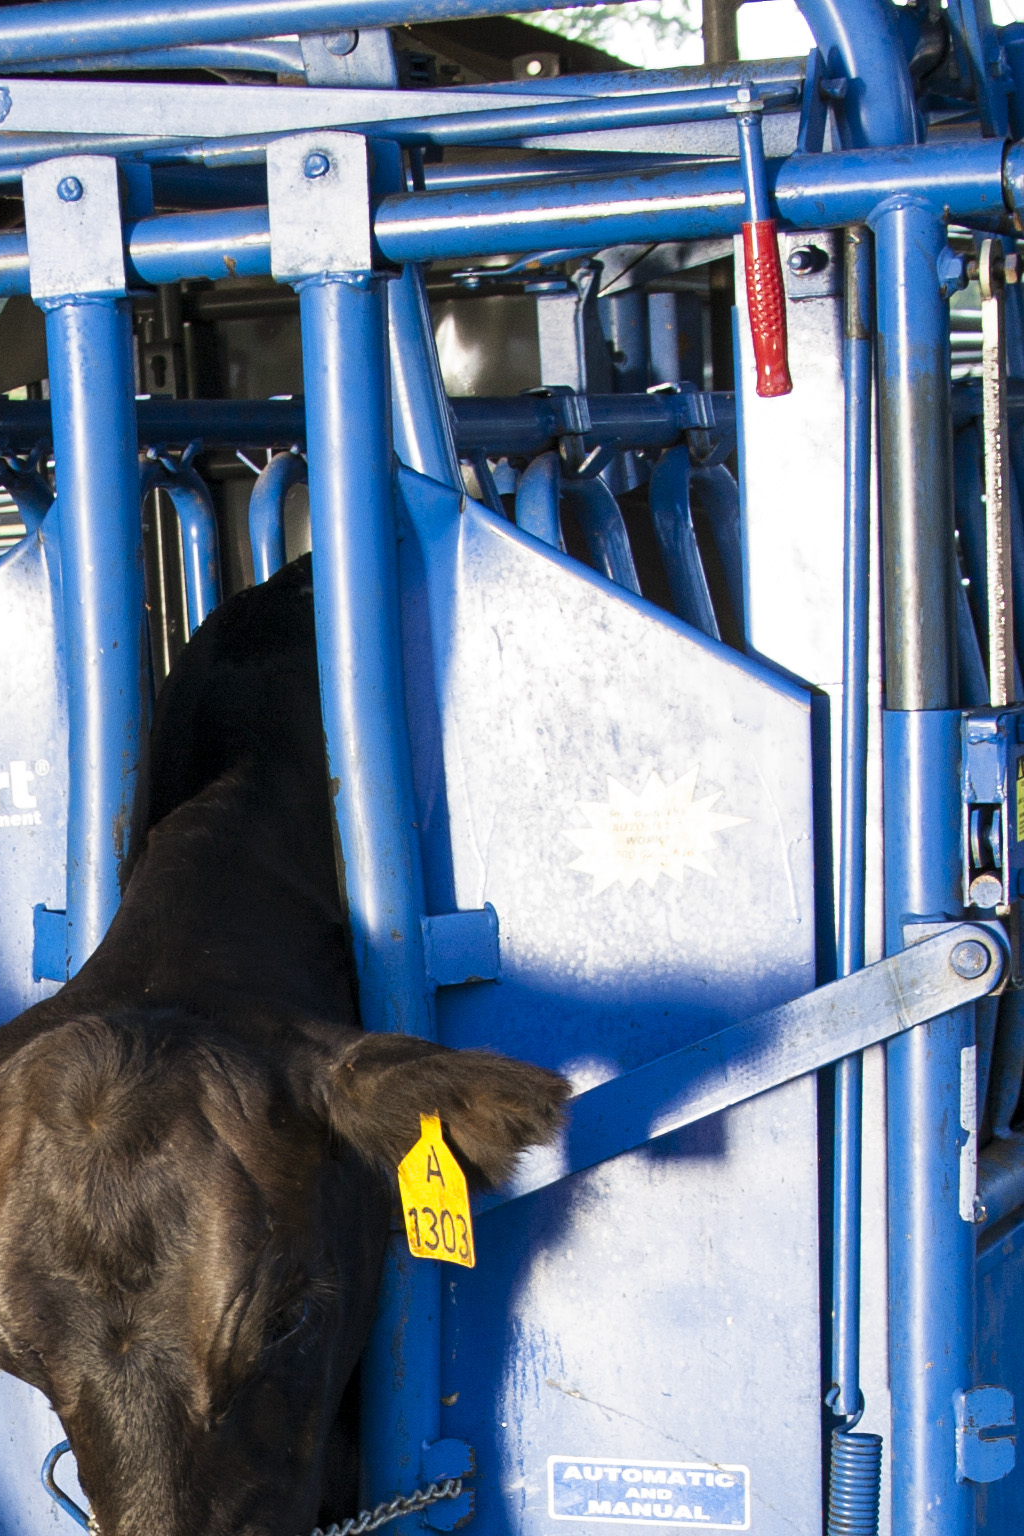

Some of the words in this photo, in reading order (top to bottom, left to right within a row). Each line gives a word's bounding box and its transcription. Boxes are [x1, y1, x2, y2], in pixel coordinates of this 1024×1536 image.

[426, 1144, 446, 1188] A
[407, 1206, 471, 1259] 1303
[562, 1465, 736, 1488] AUTOMATIC
[625, 1487, 673, 1500] AND
[586, 1500, 711, 1520] MANUAL
